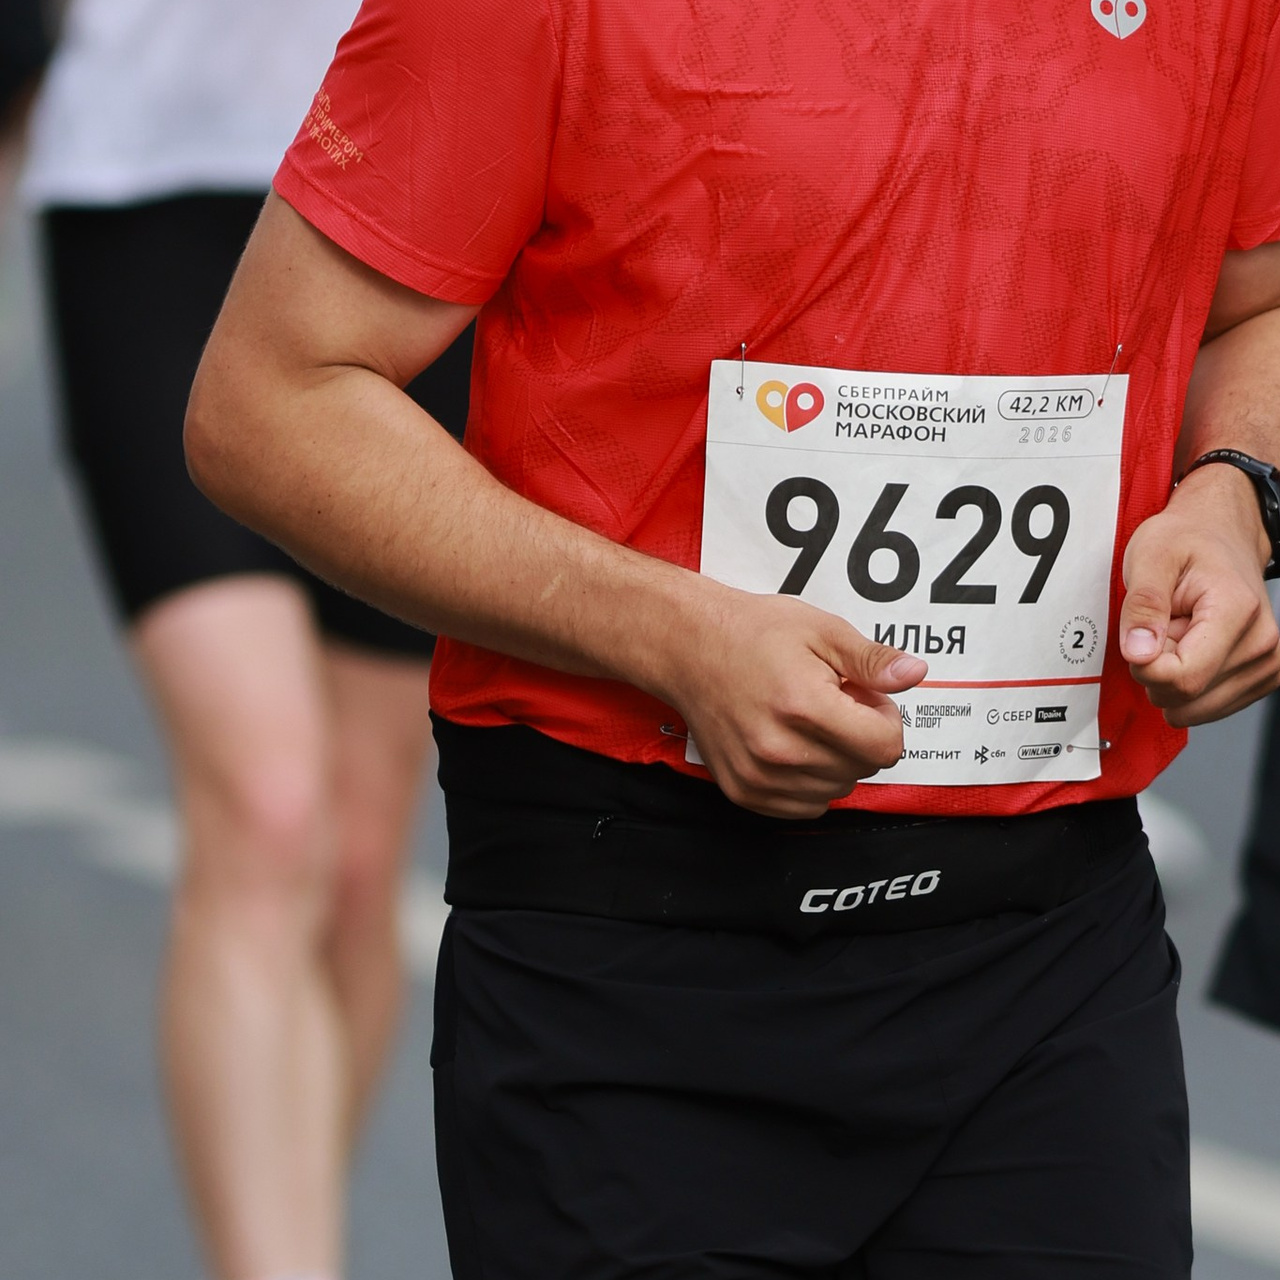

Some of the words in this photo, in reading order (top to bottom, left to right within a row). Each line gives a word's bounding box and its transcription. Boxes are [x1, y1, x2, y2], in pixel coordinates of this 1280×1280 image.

[318, 86, 331, 112] ЫТЬ
[312, 104, 364, 163] ПРИМЕРОМ
[309, 123, 350, 170] МНОГИХ
[837, 385, 949, 402] СБЕРПРАЙМ
[836, 402, 986, 424] МОСКОВСКИЙ
[1009, 397, 1049, 416] 42,2
[834, 421, 947, 442] МАРАФОН
[1018, 426, 1073, 443] 2026
[765, 476, 1070, 604] 9629
[874, 623, 966, 654] ИЛЬЯ
[1072, 630, 1085, 649] 2
[915, 703, 972, 717] МОСКОВСКИЙ
[1003, 710, 1033, 722] СБЕР
[1038, 710, 1062, 720] Прайм
[915, 716, 942, 728] СПОРТ
[909, 749, 961, 760] магнит
[990, 749, 1006, 758] сбп
[1021, 746, 1053, 757] WINLINE
